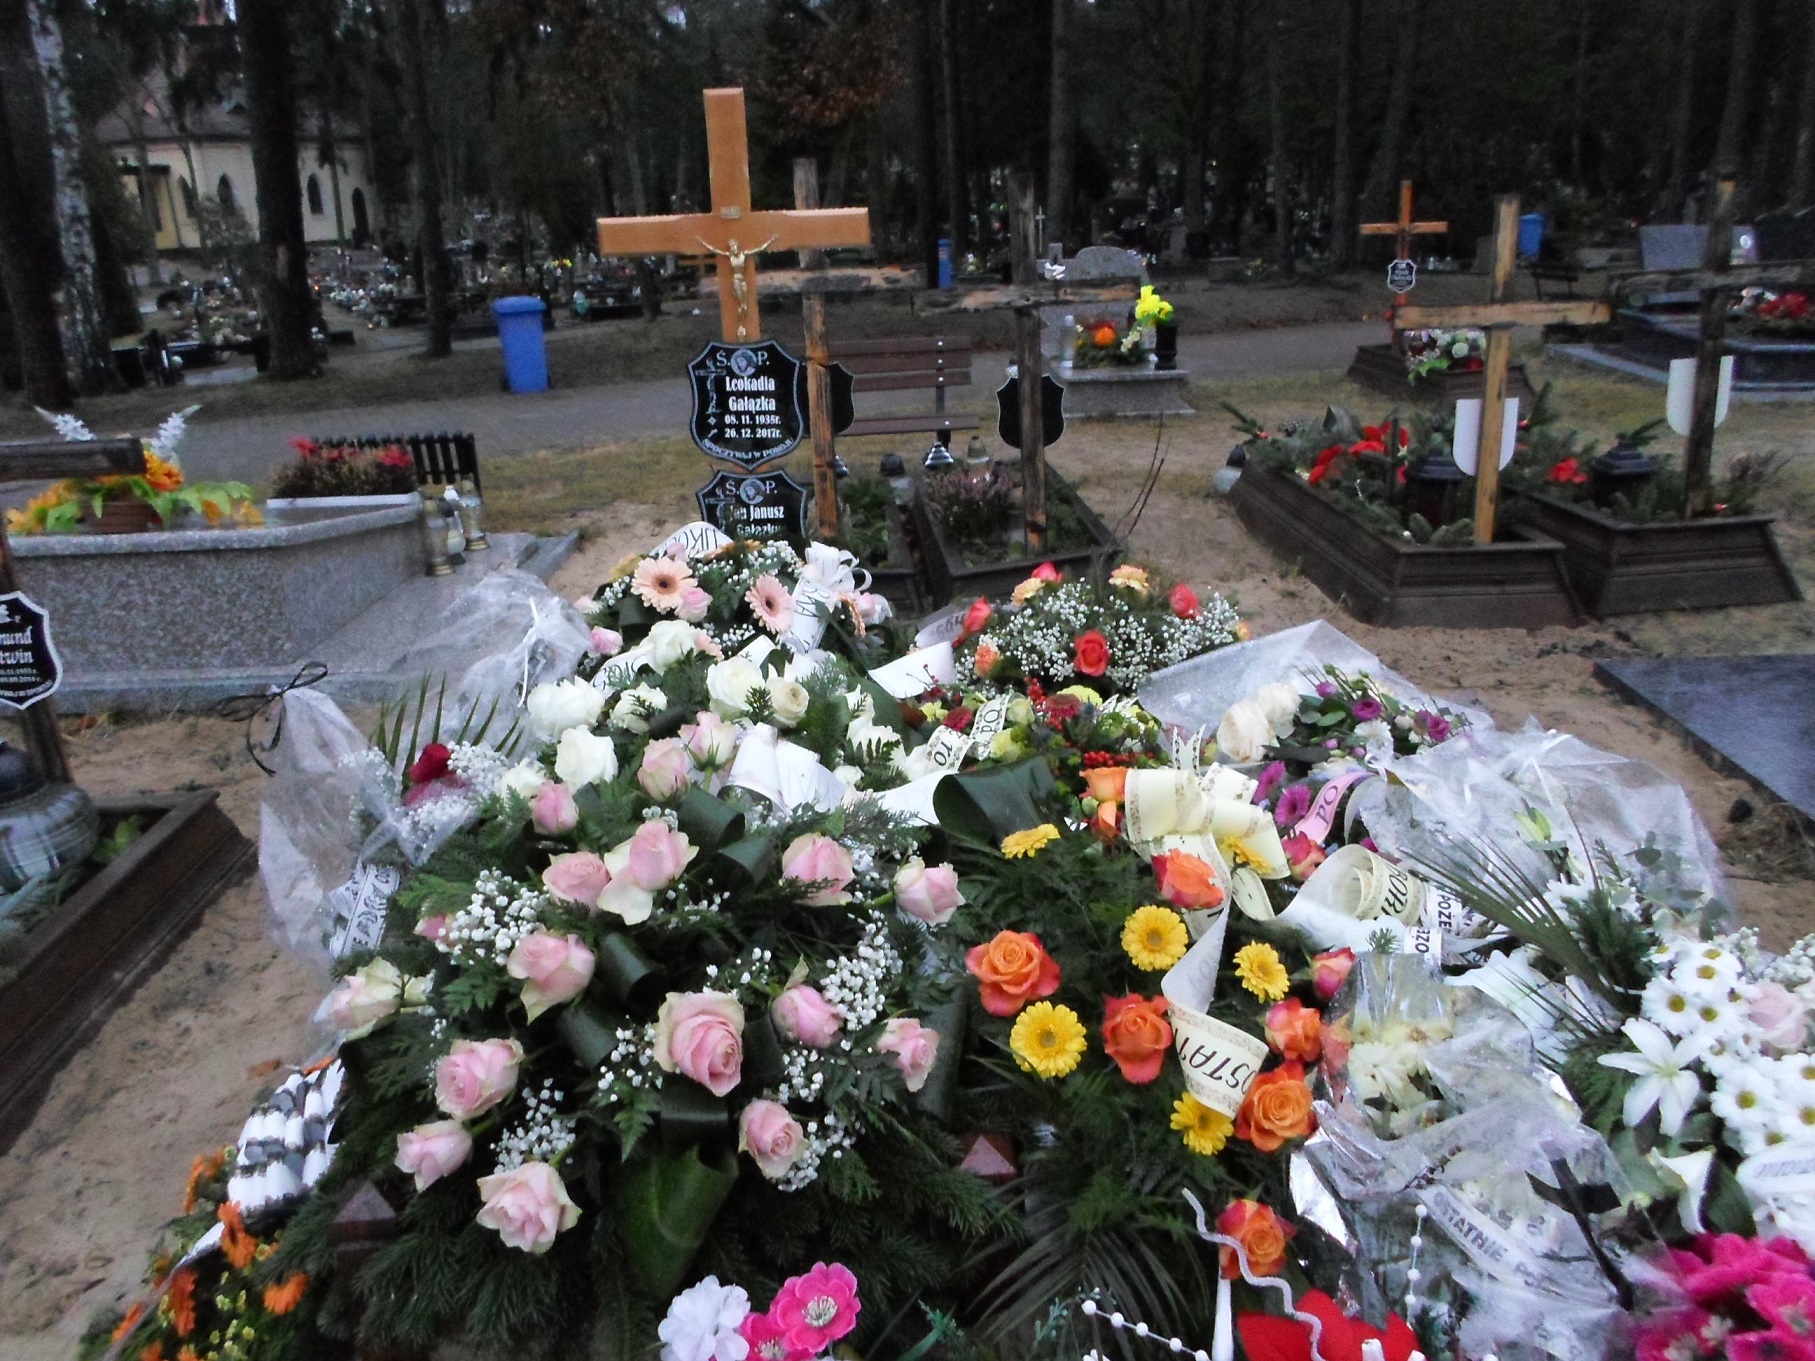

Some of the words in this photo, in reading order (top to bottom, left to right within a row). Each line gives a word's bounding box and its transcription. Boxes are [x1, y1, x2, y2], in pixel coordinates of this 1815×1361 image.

[757, 351, 770, 365] P.
[725, 376, 775, 392] Leokadia
[728, 396, 776, 414] Gałązka
[724, 415, 739, 425] 08.
[741, 415, 753, 425] 11.
[741, 428, 754, 438] 12.
[756, 428, 782, 438] 2017r.
[765, 480, 778, 494] P.
[750, 505, 785, 521] Janusz
